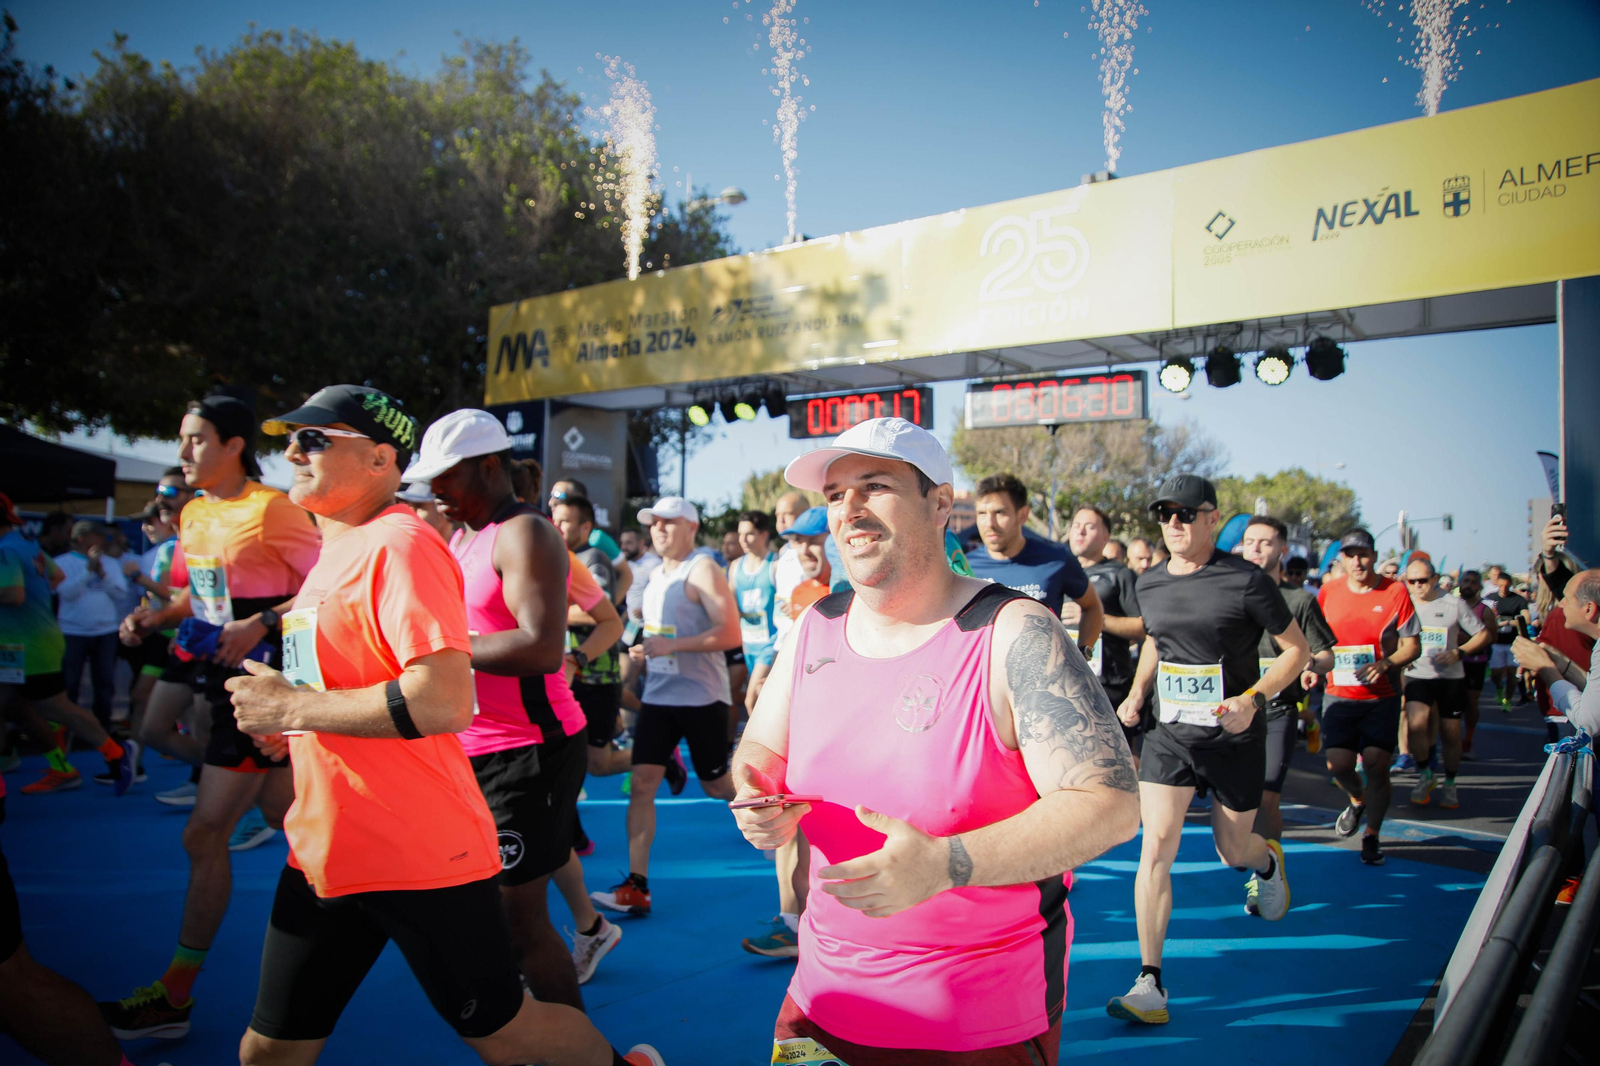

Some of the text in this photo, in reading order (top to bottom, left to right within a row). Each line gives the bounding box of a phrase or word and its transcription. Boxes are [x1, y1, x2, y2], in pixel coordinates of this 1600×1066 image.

[1497, 184, 1567, 206] CIUDAD
[1311, 188, 1420, 241] NEXAL
[979, 202, 1091, 304] 25
[645, 325, 697, 353] 2024
[757, 322, 789, 338] RUIZ
[1335, 653, 1369, 665] 1653
[1165, 675, 1215, 694] 1134
